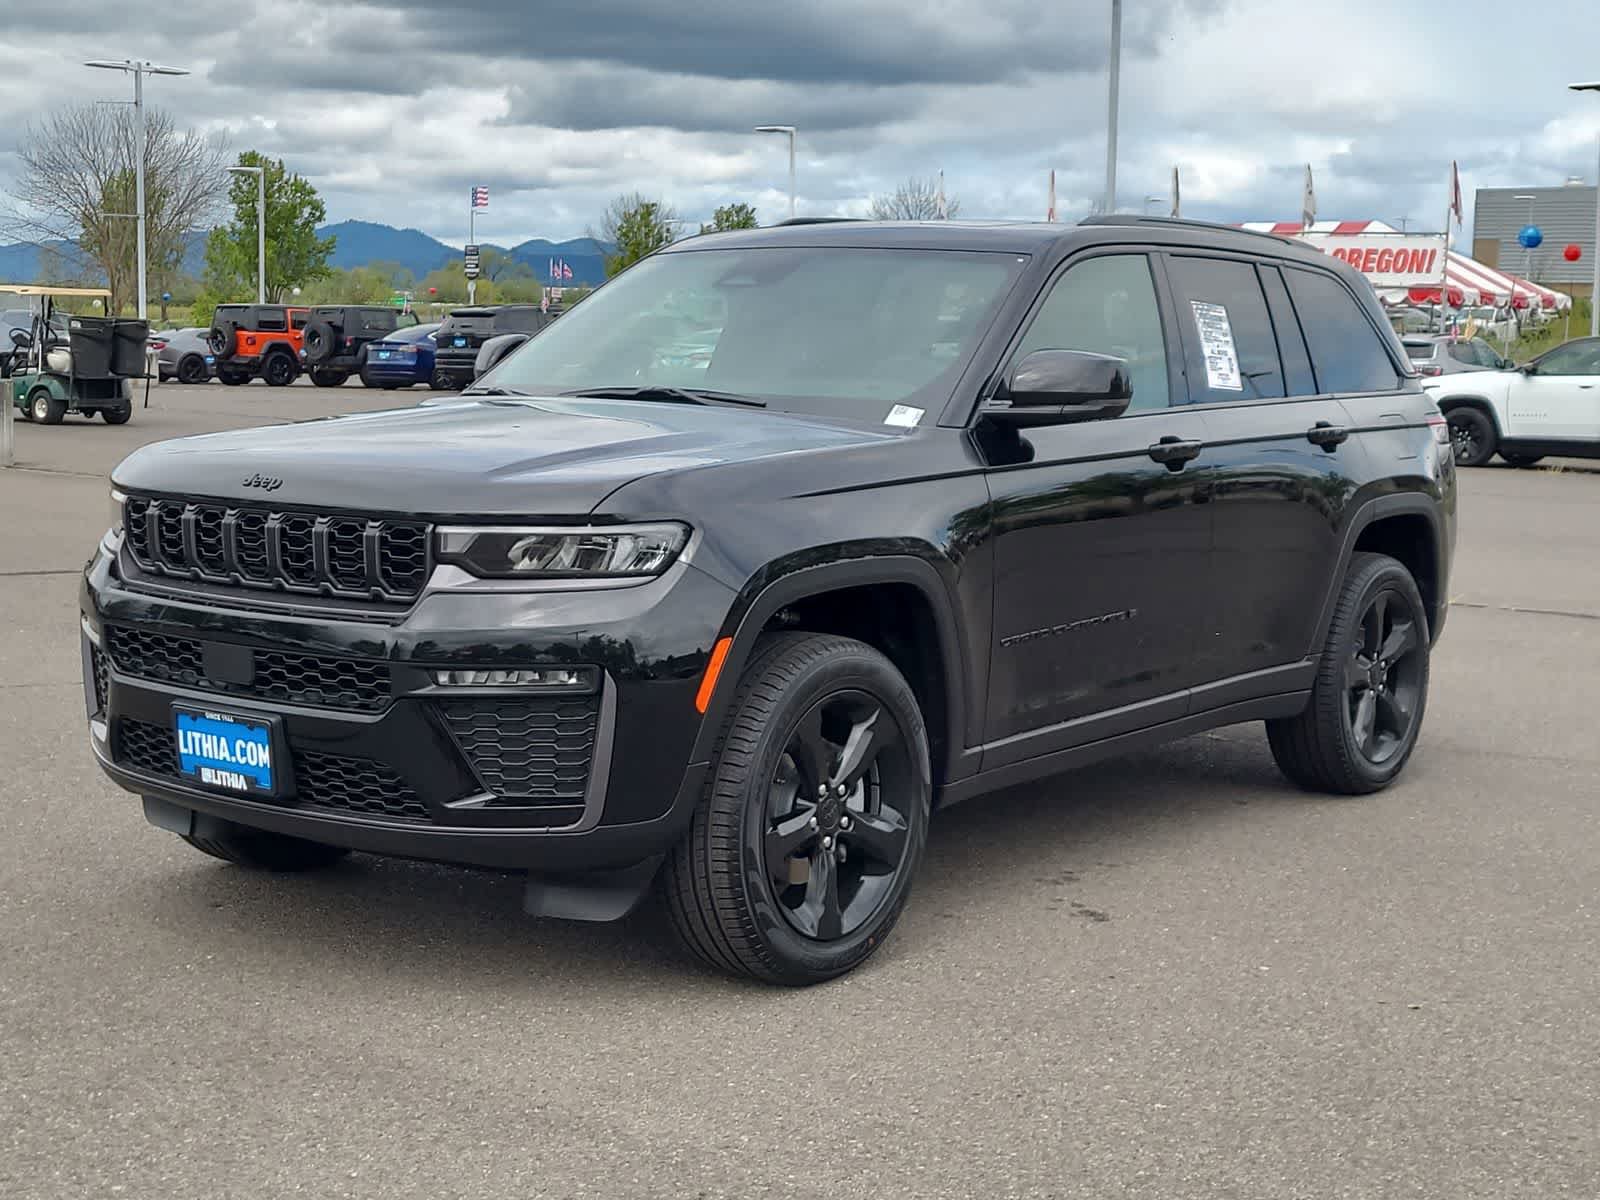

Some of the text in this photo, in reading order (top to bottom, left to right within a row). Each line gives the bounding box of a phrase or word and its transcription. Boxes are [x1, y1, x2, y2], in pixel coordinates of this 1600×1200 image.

[242, 473, 283, 492] Jeep
[178, 729, 271, 768] LITHIA.COM
[212, 769, 248, 790] LITHIA
